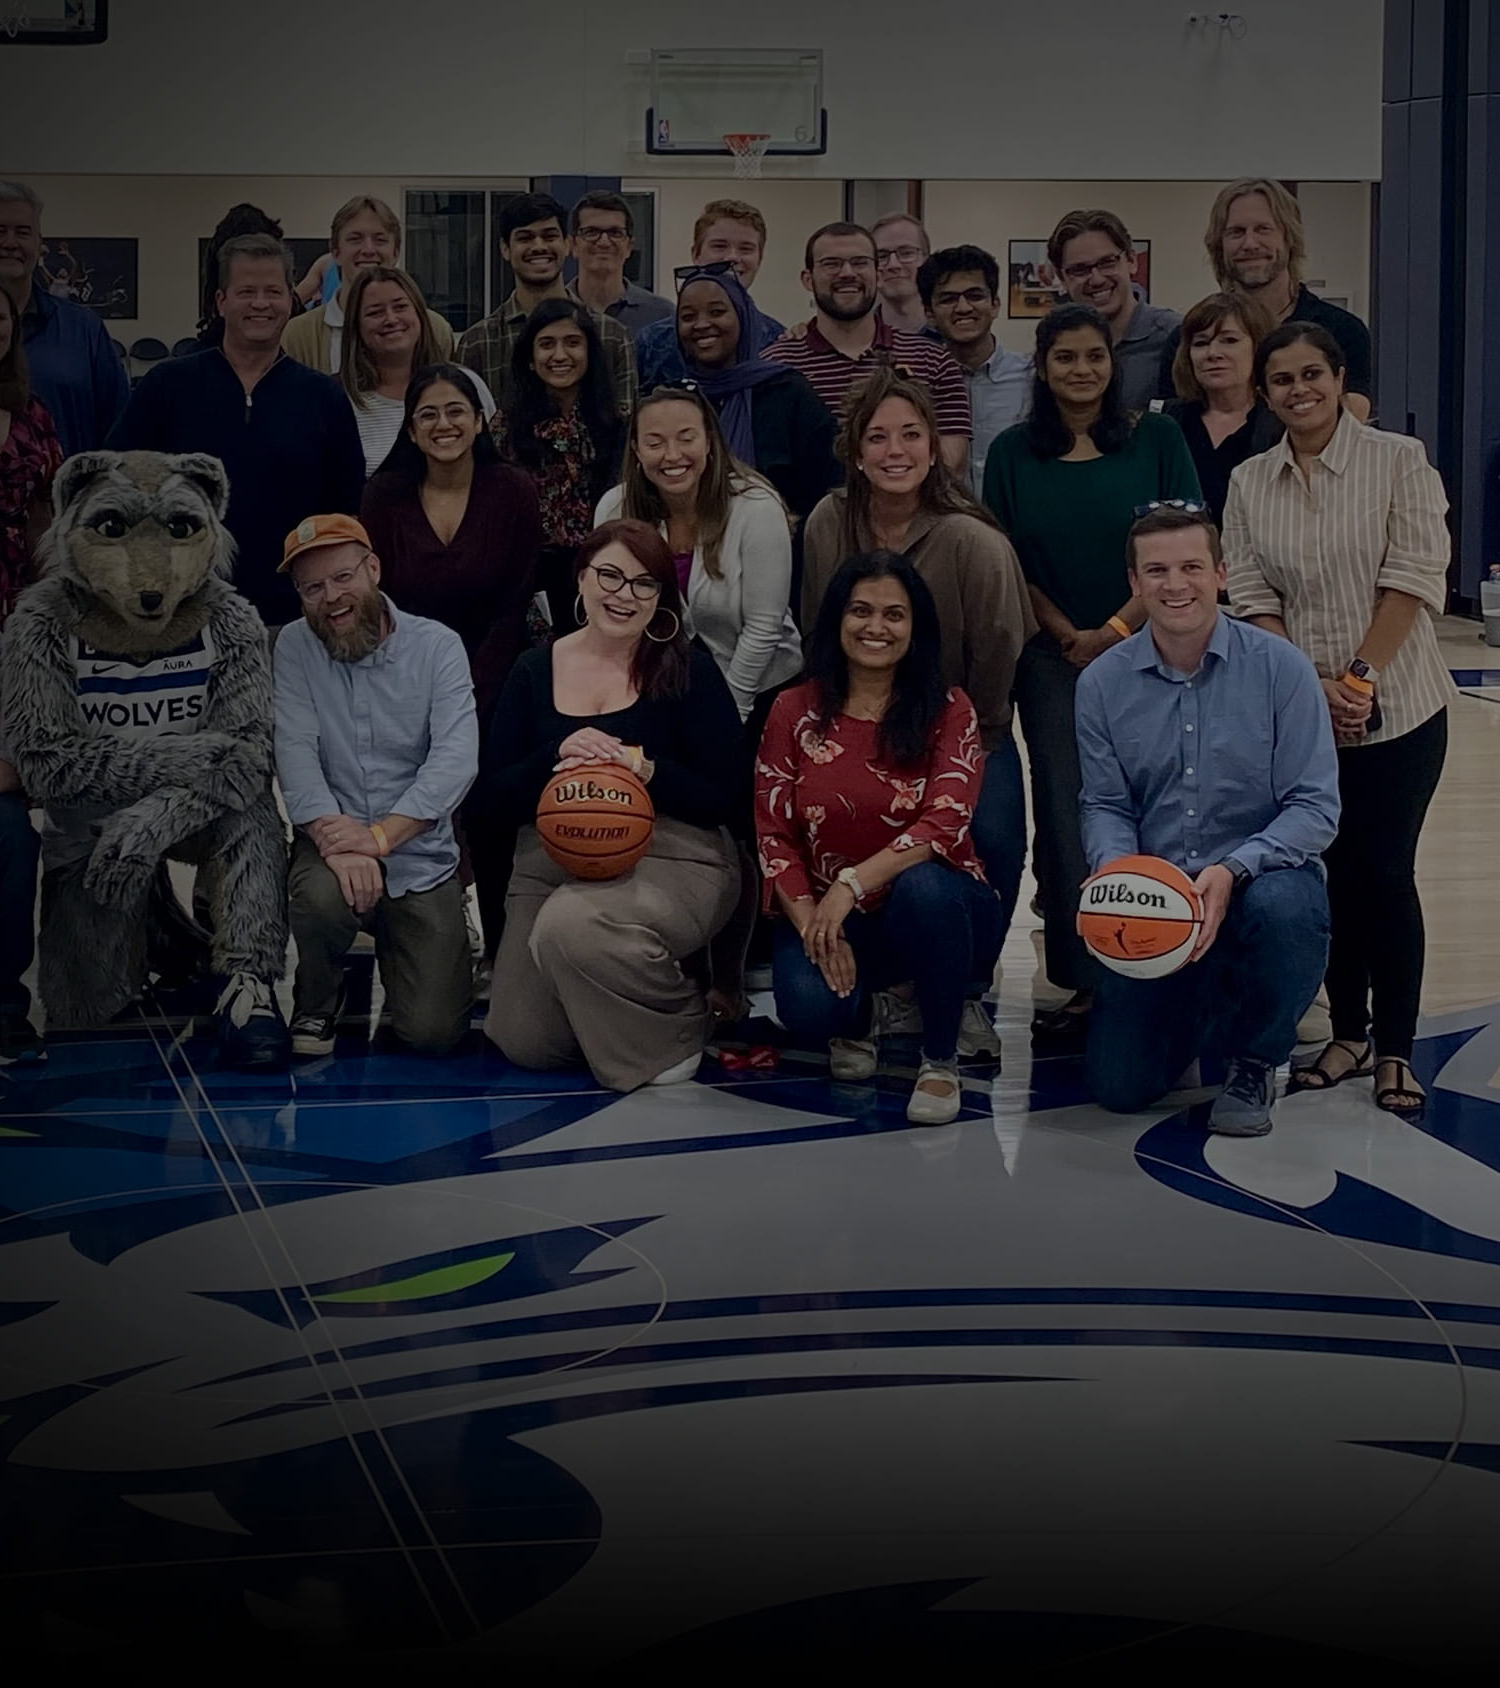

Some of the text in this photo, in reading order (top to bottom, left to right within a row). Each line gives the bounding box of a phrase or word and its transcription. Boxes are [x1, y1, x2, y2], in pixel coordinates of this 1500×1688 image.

[81, 695, 202, 727] WOLVES
[554, 781, 632, 805] Wilson
[555, 824, 630, 839] EVOLUTION
[1090, 883, 1166, 908] Wilson
